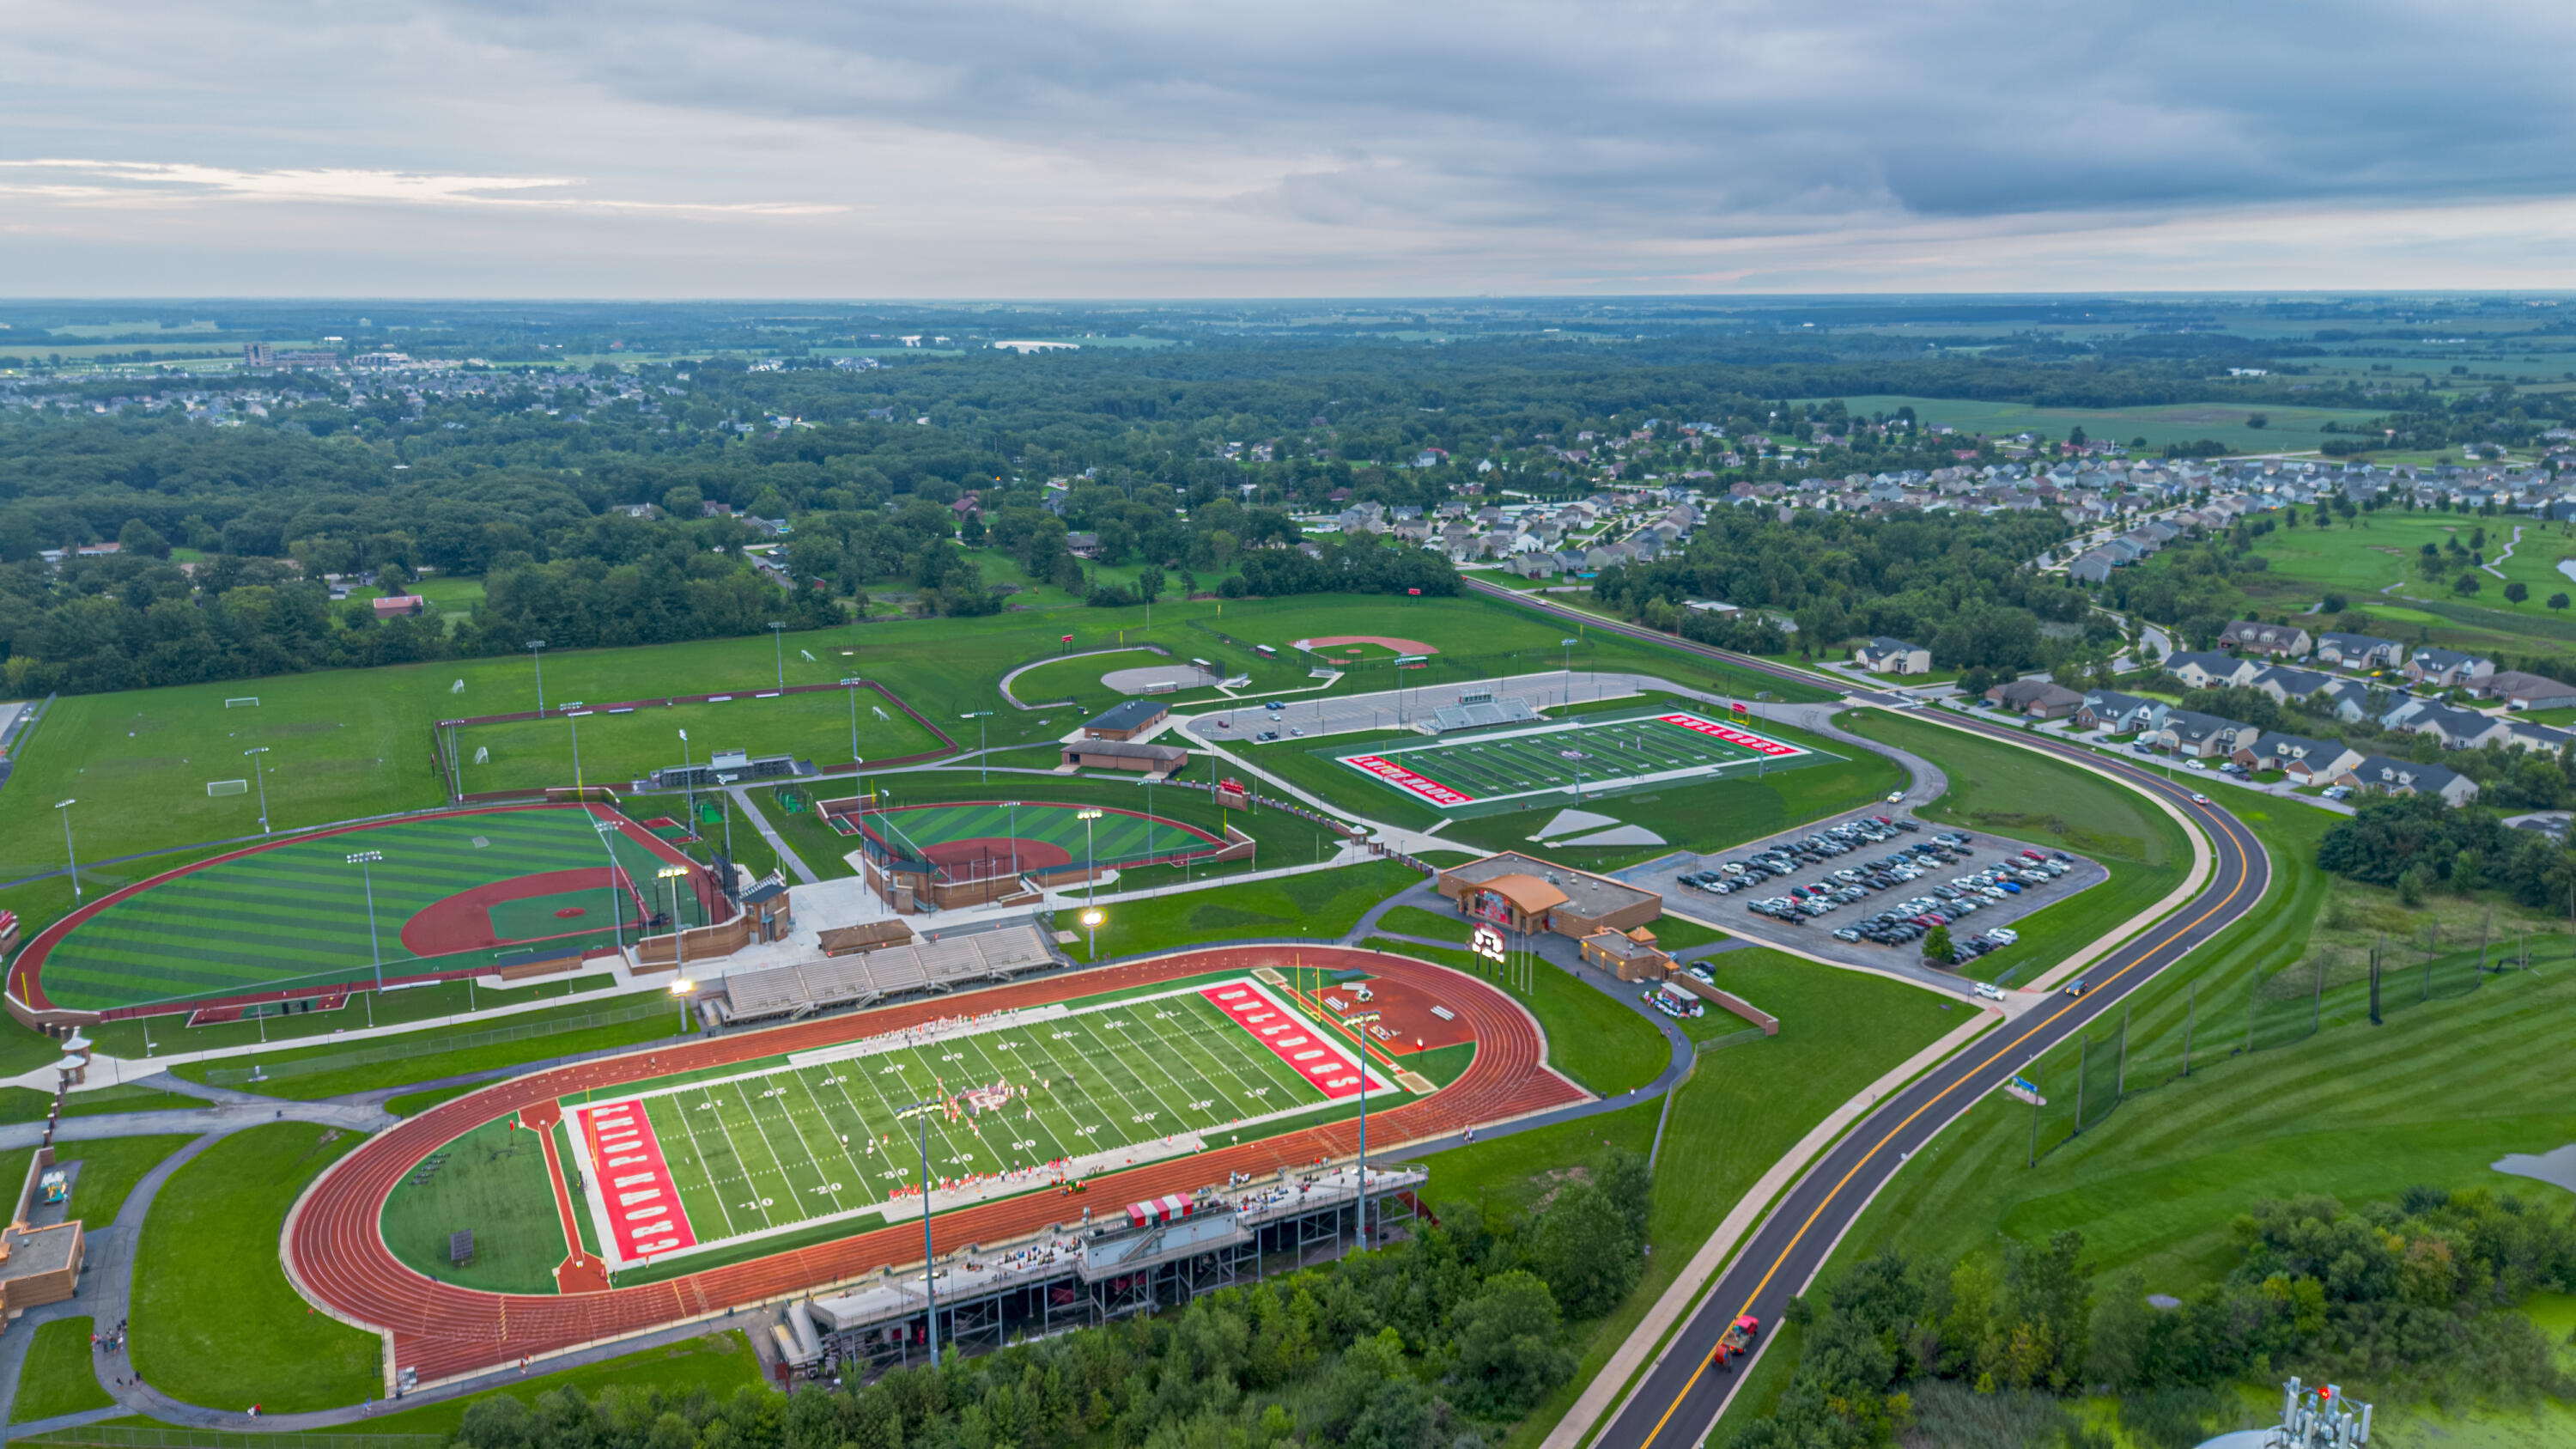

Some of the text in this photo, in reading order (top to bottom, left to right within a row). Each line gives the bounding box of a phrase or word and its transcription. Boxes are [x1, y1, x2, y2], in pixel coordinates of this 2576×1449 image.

[1669, 717, 1785, 752] BULLDOGS
[1354, 758, 1466, 803] CROWN POINT
[1218, 990, 1360, 1088] BULLDOGS
[1243, 1088, 1267, 1098] 10
[1188, 1100, 1212, 1111] 20
[1132, 1112, 1155, 1123] 30
[1074, 1126, 1097, 1135] 40
[1012, 1139, 1036, 1150] 50
[950, 1154, 974, 1164] 40
[592, 1105, 679, 1253] CROWN POINT
[884, 1168, 908, 1179] 30
[817, 1183, 842, 1195] 20
[749, 1197, 773, 1210] 10
